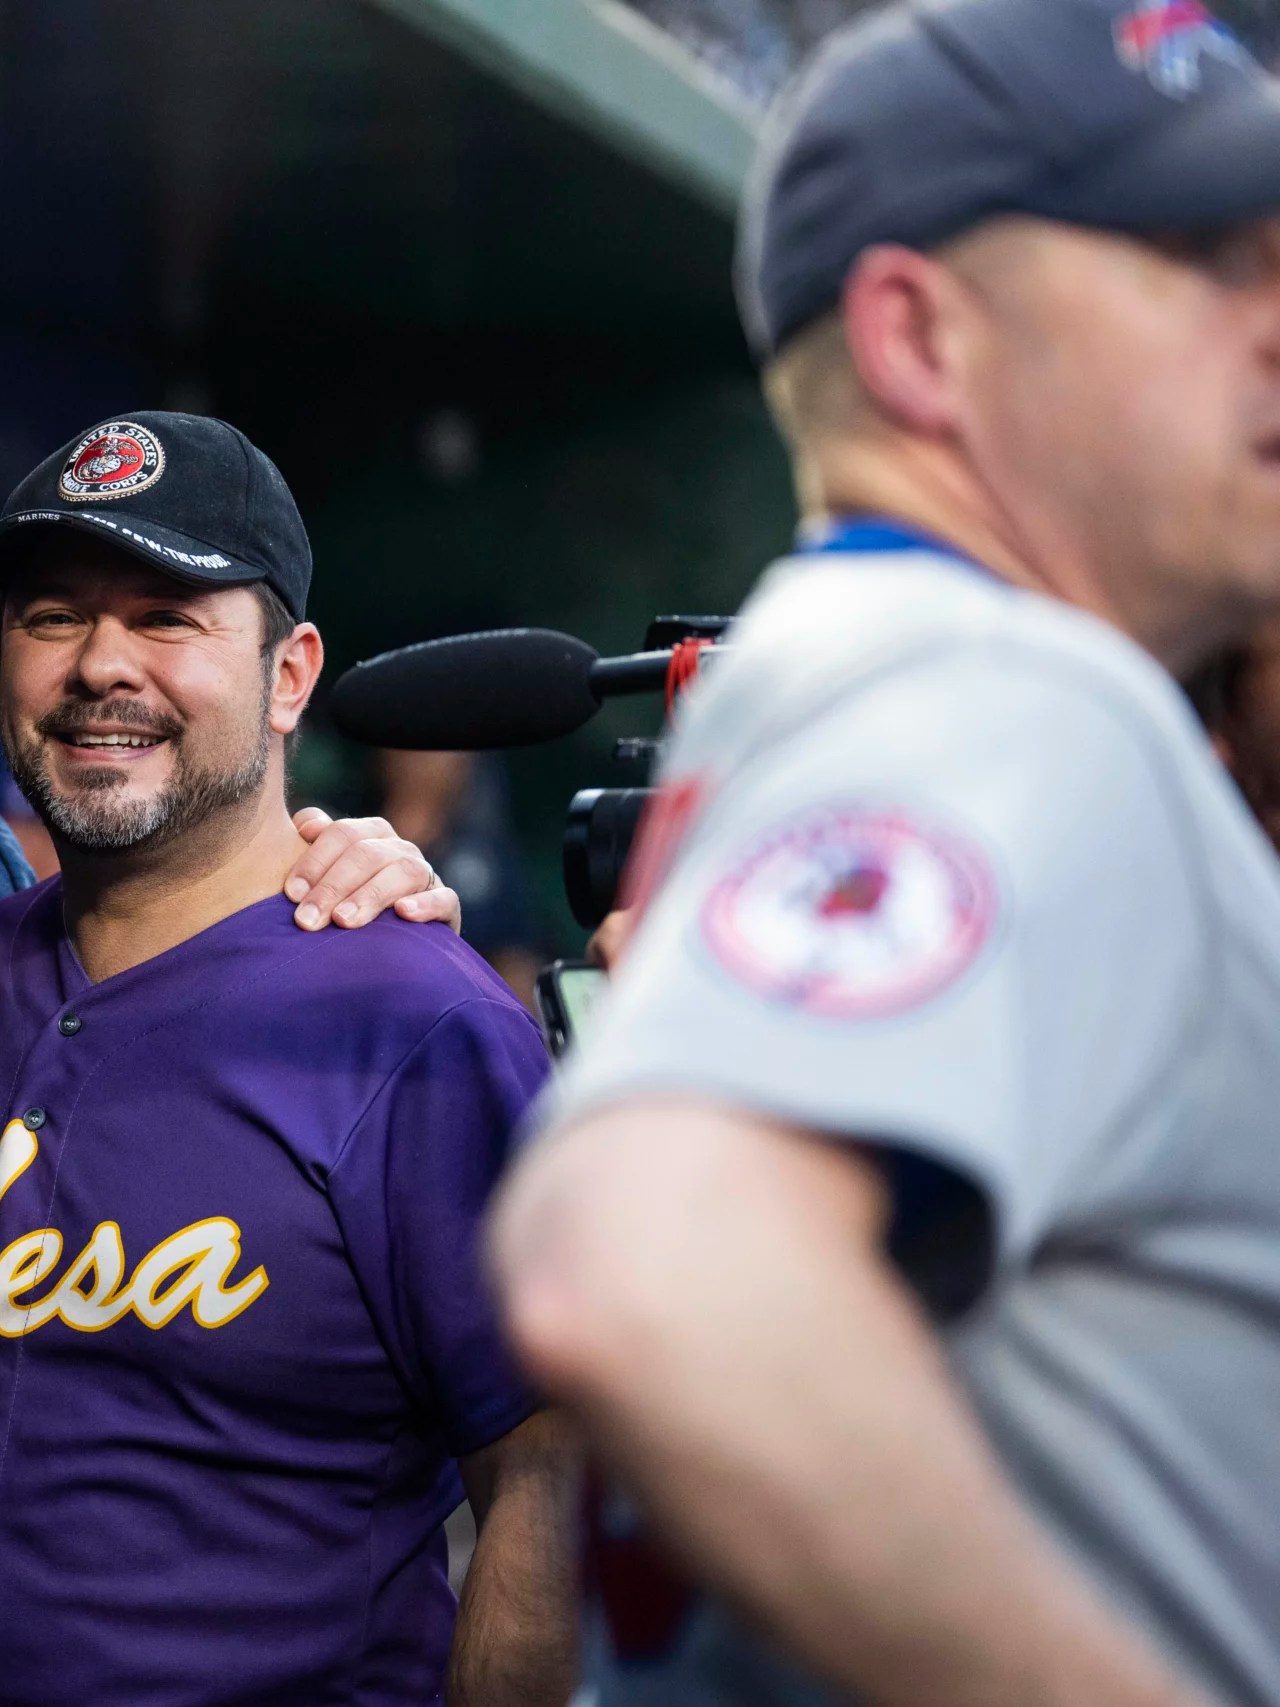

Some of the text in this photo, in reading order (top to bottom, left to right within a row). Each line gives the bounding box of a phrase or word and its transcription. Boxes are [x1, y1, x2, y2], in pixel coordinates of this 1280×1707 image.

[69, 425, 156, 466] UNITED STATES
[63, 469, 148, 492] MARINE CORPS
[18, 513, 60, 522] MARINES
